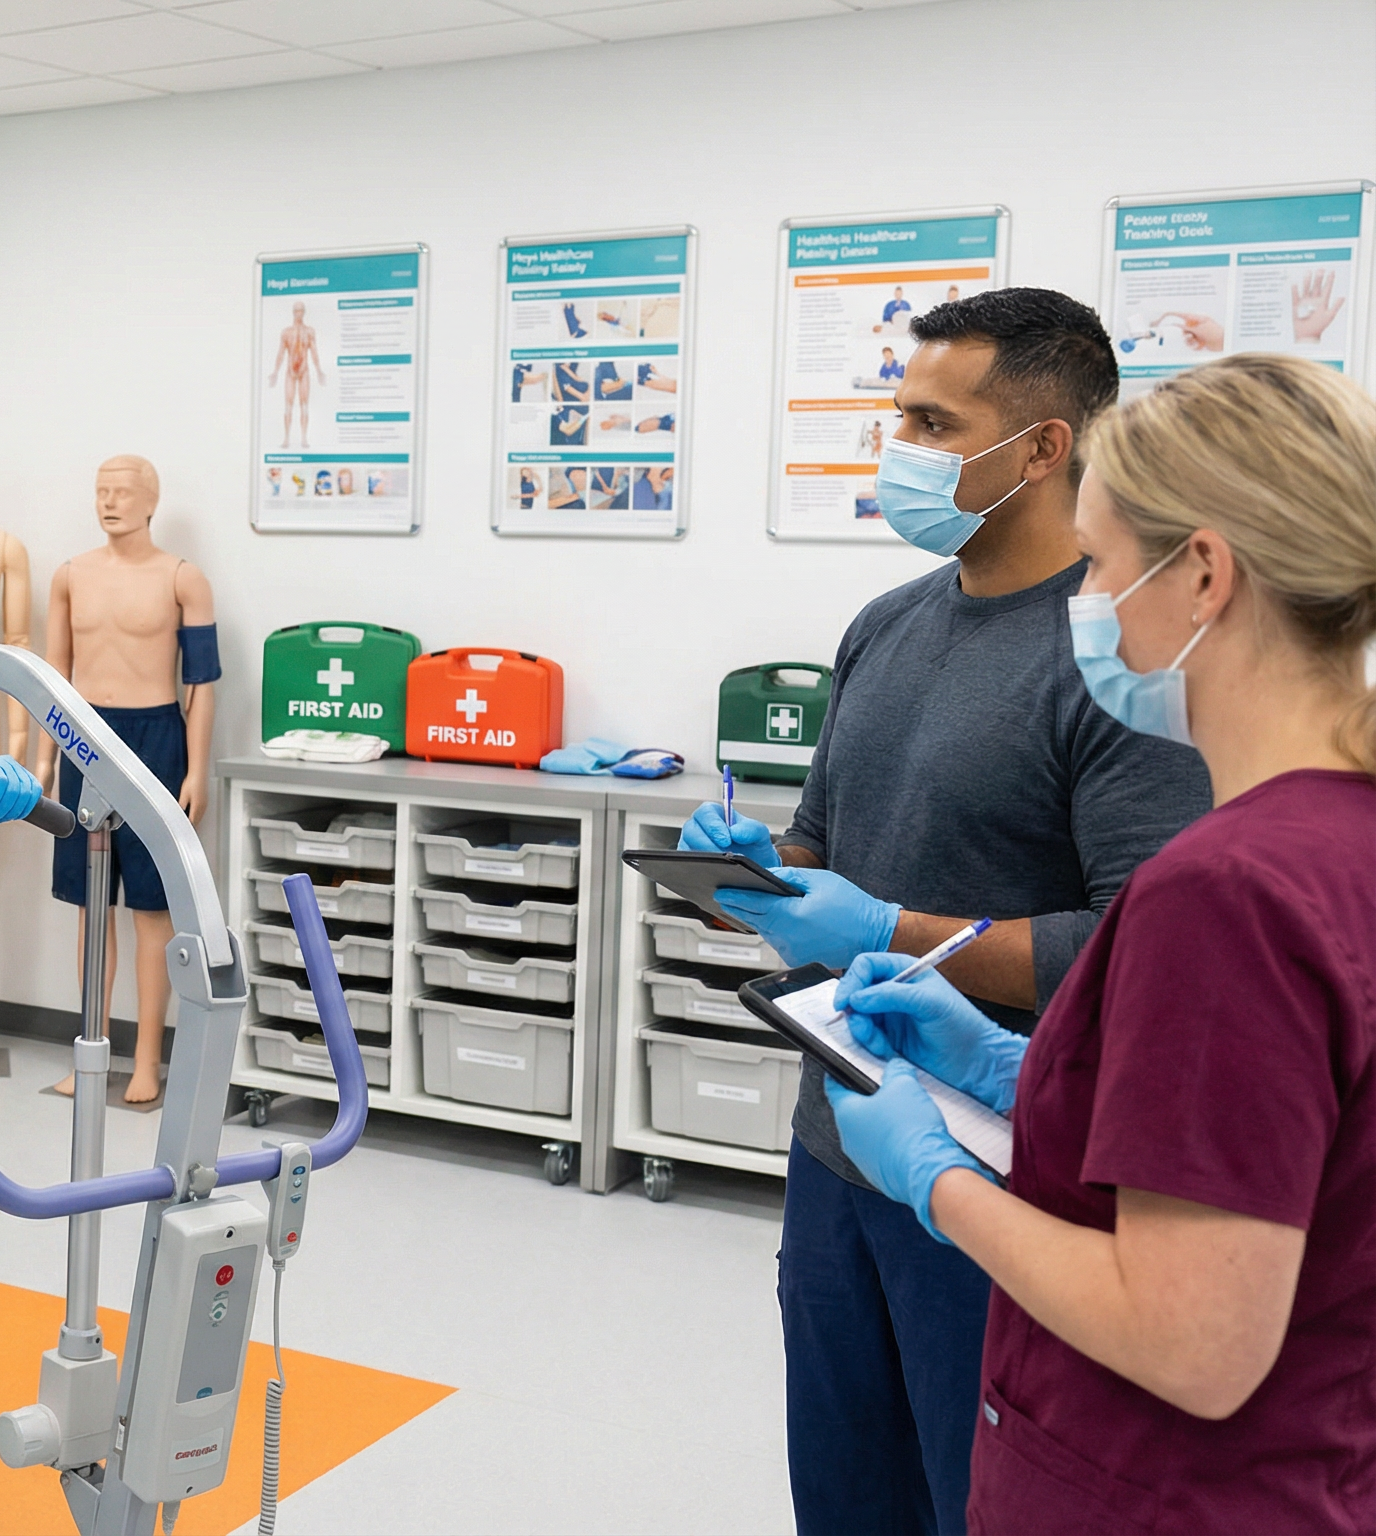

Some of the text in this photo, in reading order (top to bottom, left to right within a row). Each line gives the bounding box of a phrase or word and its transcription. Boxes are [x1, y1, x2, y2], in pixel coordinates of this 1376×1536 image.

[288, 700, 384, 720] FIRST AID
[45, 704, 99, 767] Hoyer
[427, 725, 516, 747] FIRST AID
